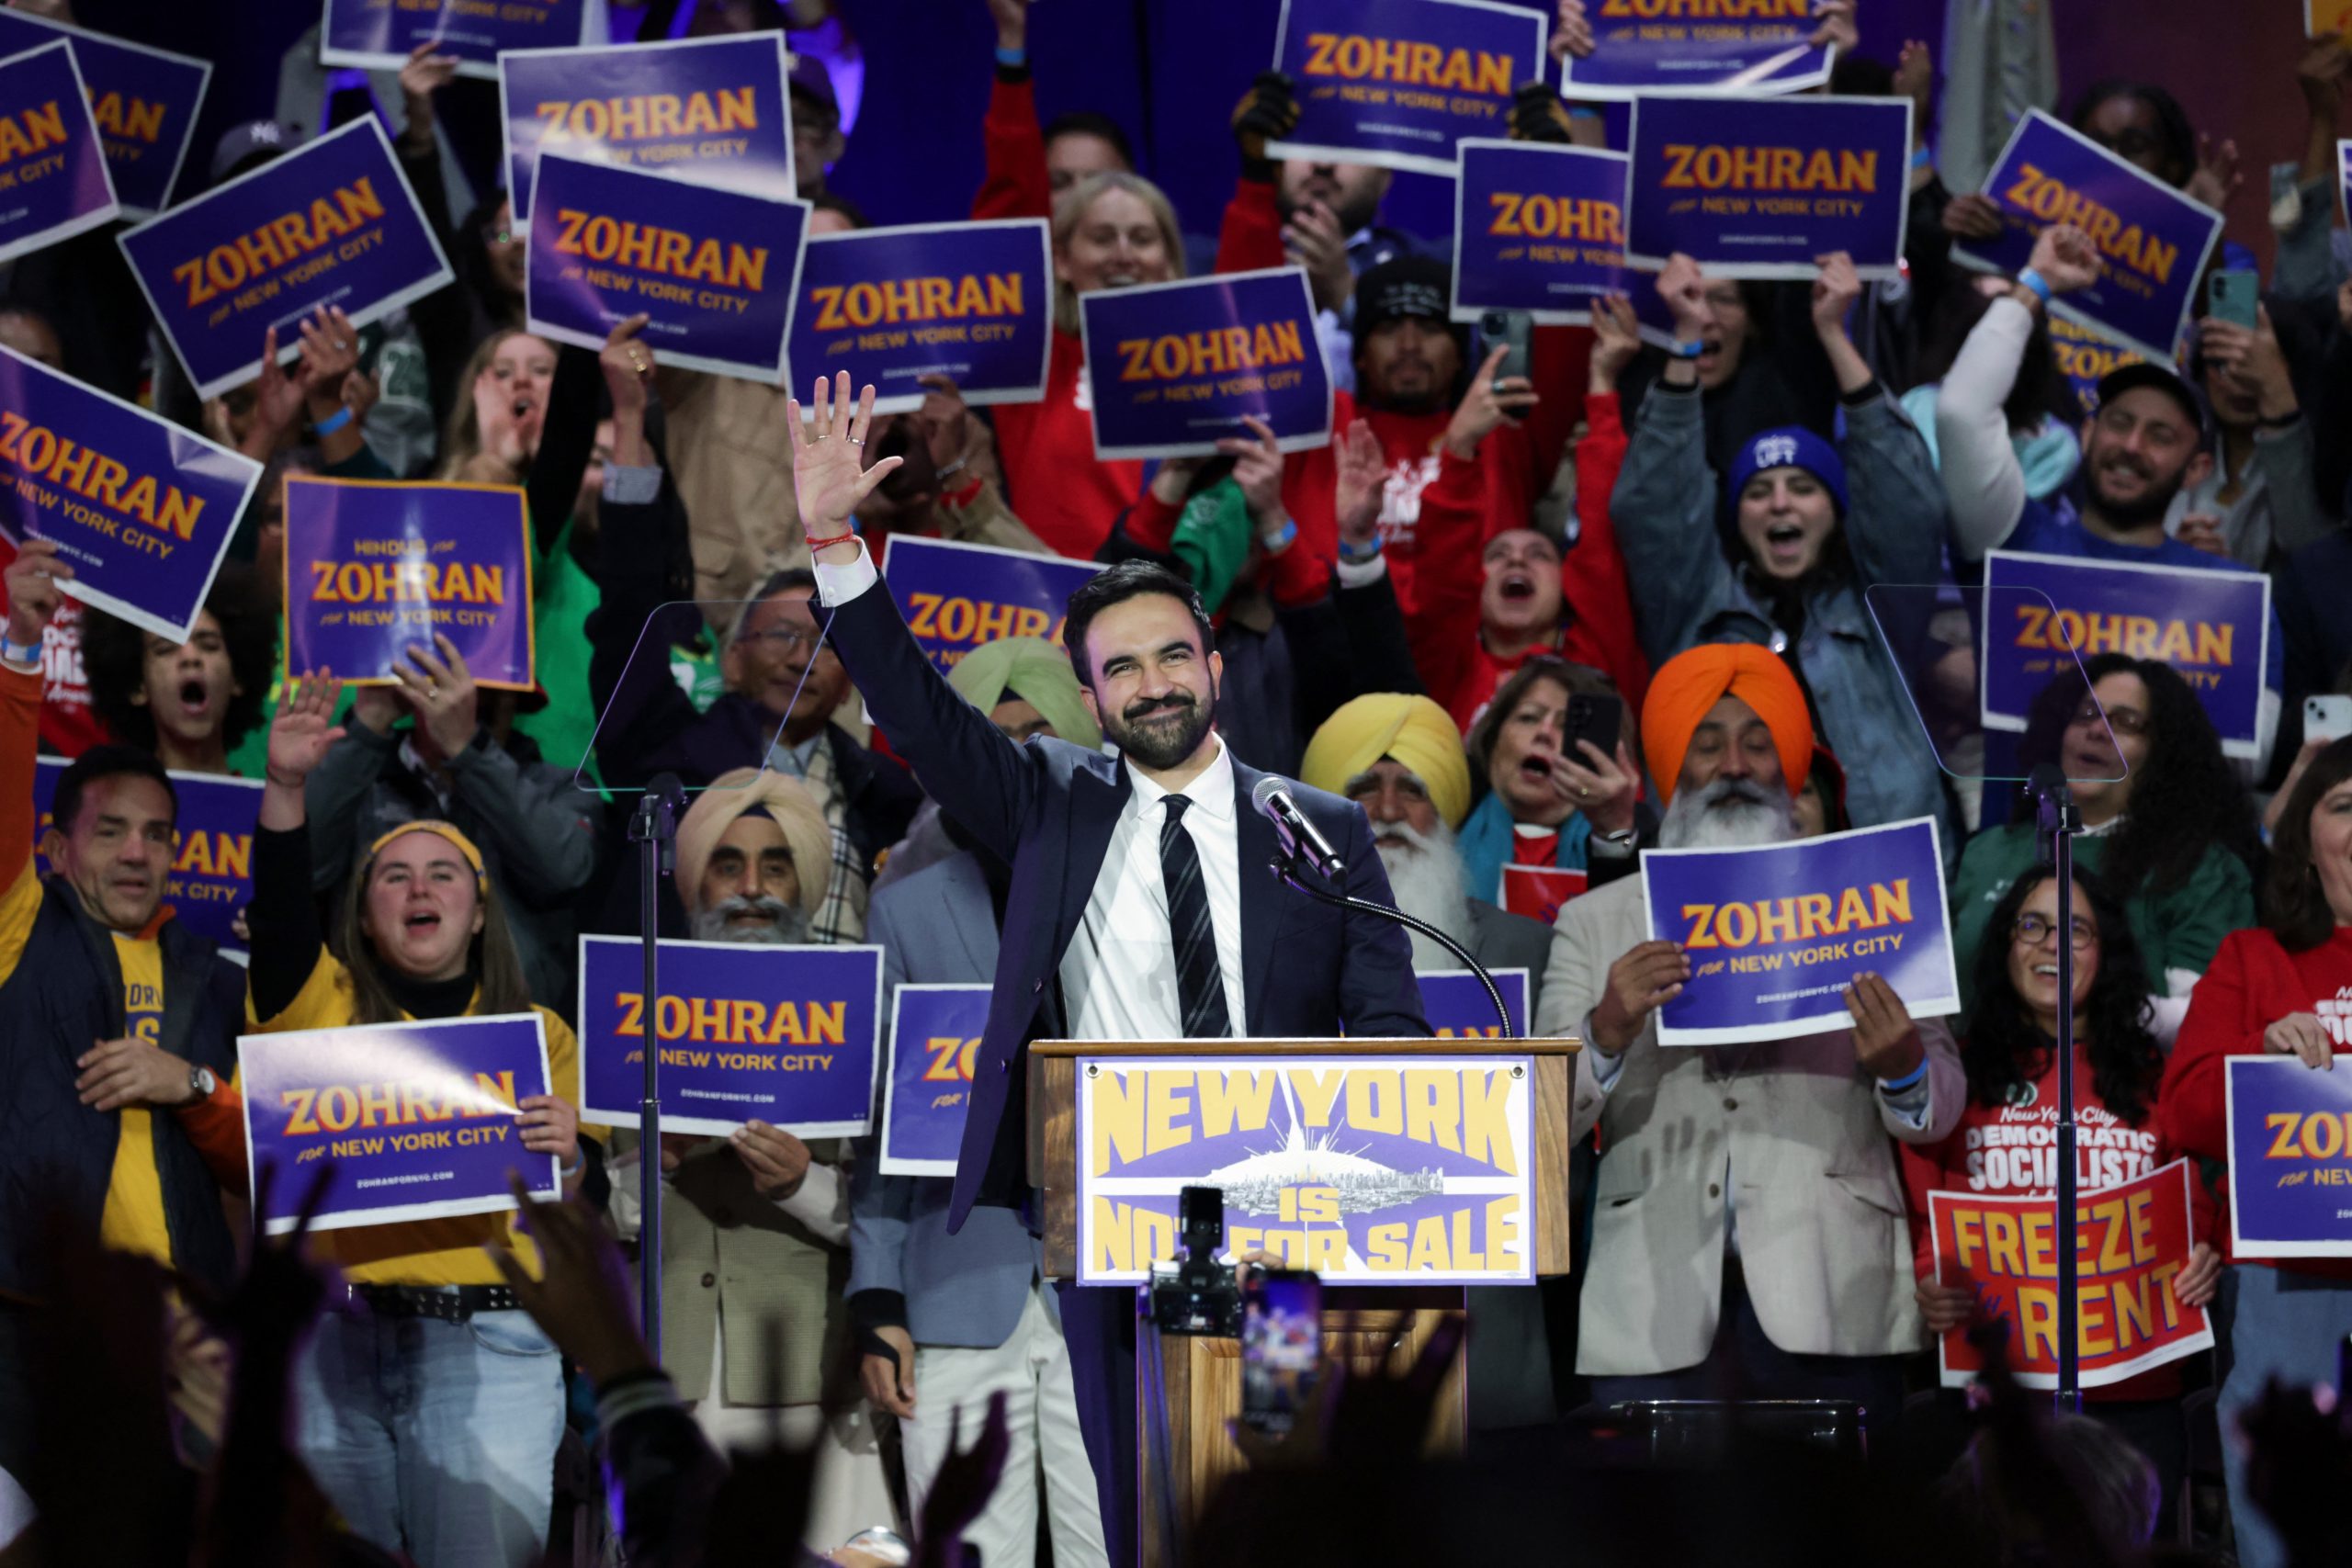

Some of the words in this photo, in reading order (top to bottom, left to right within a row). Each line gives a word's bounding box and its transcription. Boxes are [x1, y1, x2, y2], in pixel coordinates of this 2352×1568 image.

[1304, 33, 1513, 96] ZOHRAN
[536, 86, 758, 141] ZOHRAN
[1340, 85, 1388, 104] NEW
[1392, 90, 1448, 111] YORK
[1450, 97, 1498, 118] CITY
[1661, 144, 1879, 192] ZOHRAN
[1489, 192, 1625, 245] ZOHR
[1702, 197, 1750, 215] NEW
[1754, 197, 1811, 215] YORK
[1814, 198, 1864, 218] CITY
[2007, 162, 2178, 285] ZOHRAN
[173, 176, 385, 309] ZOHRAN
[233, 279, 280, 311] NEW
[283, 252, 338, 288] YORK
[338, 228, 384, 262] CITY
[554, 208, 769, 291] ZOHRAN
[1581, 248, 1625, 267] YOR
[587, 269, 633, 292] NEW
[639, 279, 694, 305] YORK
[698, 291, 749, 314] CITY
[810, 274, 1024, 331] ZOHRAN
[858, 332, 909, 352] NEW
[912, 327, 968, 345] YORK
[971, 324, 1015, 343] CITY
[1117, 320, 1305, 381] ZOHRAN
[0, 412, 206, 541] ZOHRAN
[16, 475, 59, 510] NEW
[62, 499, 119, 538] YORK
[122, 527, 174, 559] CITY
[311, 560, 503, 605] ZOHRAN
[348, 609, 395, 626] NEW
[401, 608, 453, 626] YORK
[457, 610, 496, 626] CITY
[909, 592, 1068, 648] ZOHR
[2014, 604, 2234, 666] ZOHRAN
[188, 882, 237, 903] CITY
[1681, 878, 1914, 949] ZOHRAN
[1730, 954, 1784, 975] NEW
[1789, 944, 1849, 967] YORK
[1853, 933, 1904, 955] CITY
[615, 992, 847, 1044] ZOHRAN
[660, 1049, 710, 1066] NEW
[716, 1053, 776, 1071] YORK
[781, 1055, 833, 1071] CITY
[281, 1071, 517, 1136] ZOHRAN
[1091, 1069, 1278, 1178] NEW
[1287, 1068, 1520, 1177] YORK
[2000, 1107, 2036, 1122] New
[2080, 1106, 2118, 1127] City
[331, 1139, 384, 1159] NEW
[390, 1131, 451, 1154] YORK
[457, 1125, 509, 1146] CITY
[1092, 1195, 1180, 1271] NO
[1229, 1225, 1349, 1271] FOR
[1366, 1194, 1521, 1271] SALE
[1279, 1187, 1340, 1223] IS
[1951, 1190, 2156, 1279] FREEZE
[2018, 1261, 2181, 1361] RENT
